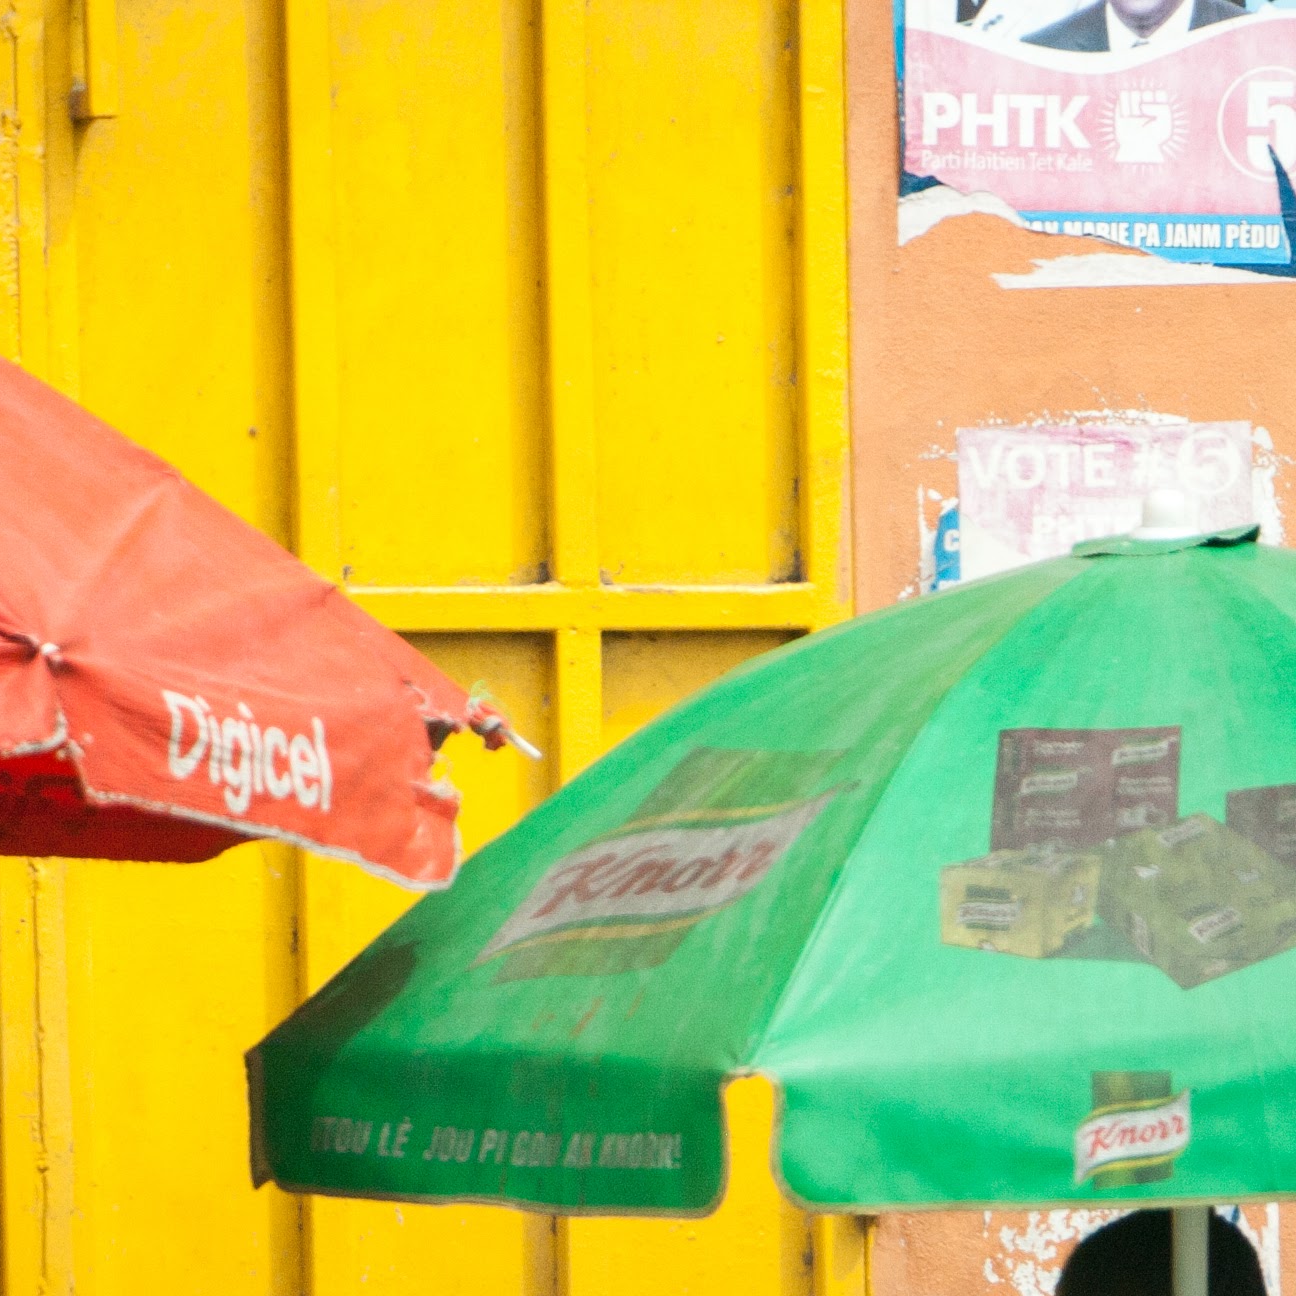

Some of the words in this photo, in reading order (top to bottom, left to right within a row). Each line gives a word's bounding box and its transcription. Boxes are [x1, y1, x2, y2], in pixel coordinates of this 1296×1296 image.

[921, 92, 1092, 149] PHTK
[921, 149, 960, 171] Parti
[1055, 151, 1093, 174] Kale
[1132, 221, 1161, 248] PA
[1164, 222, 1221, 249] JANM
[967, 444, 1116, 489] VOTE
[161, 689, 332, 815] Digicel
[530, 841, 775, 920] Knorr
[1084, 1113, 1185, 1159] Knorr
